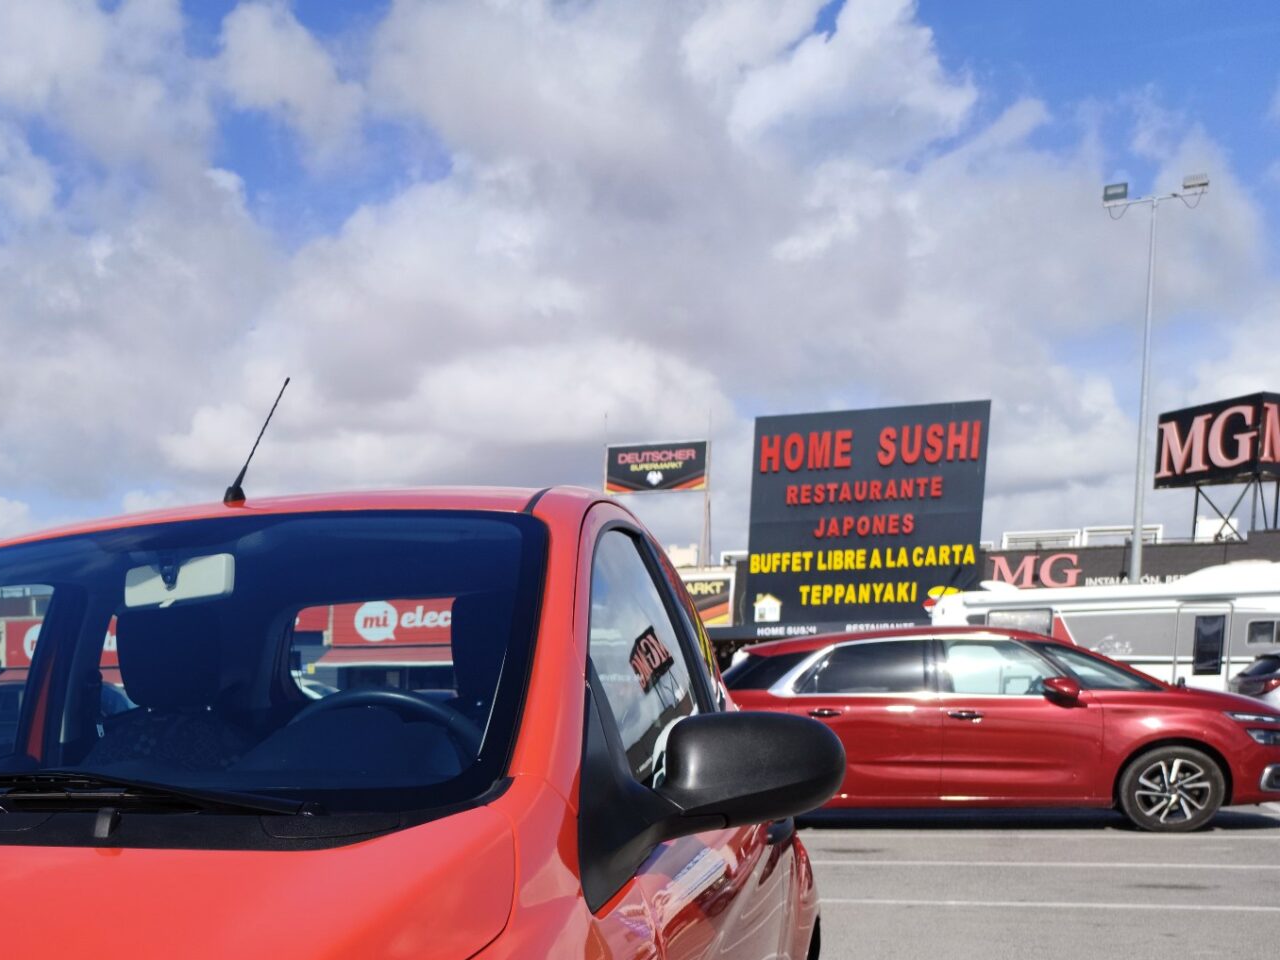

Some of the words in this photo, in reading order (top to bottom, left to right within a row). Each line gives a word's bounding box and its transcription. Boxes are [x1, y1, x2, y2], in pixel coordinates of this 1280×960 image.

[618, 449, 696, 464] DEUTSCHER
[760, 430, 853, 472] HOME
[877, 420, 982, 466] SUSHI
[630, 461, 683, 471] SUPERMARKT
[786, 476, 943, 505] RESTAURANTE
[813, 513, 915, 538] JAPONES
[750, 552, 813, 574] BUFFET
[817, 549, 867, 571] LIBRE
[869, 548, 882, 569] A
[886, 547, 909, 568] LA
[912, 544, 976, 567] CARTA
[989, 553, 1083, 589] MG
[799, 582, 918, 605] TEPPANYAKI
[363, 610, 389, 629] mi
[757, 626, 785, 636] HOME
